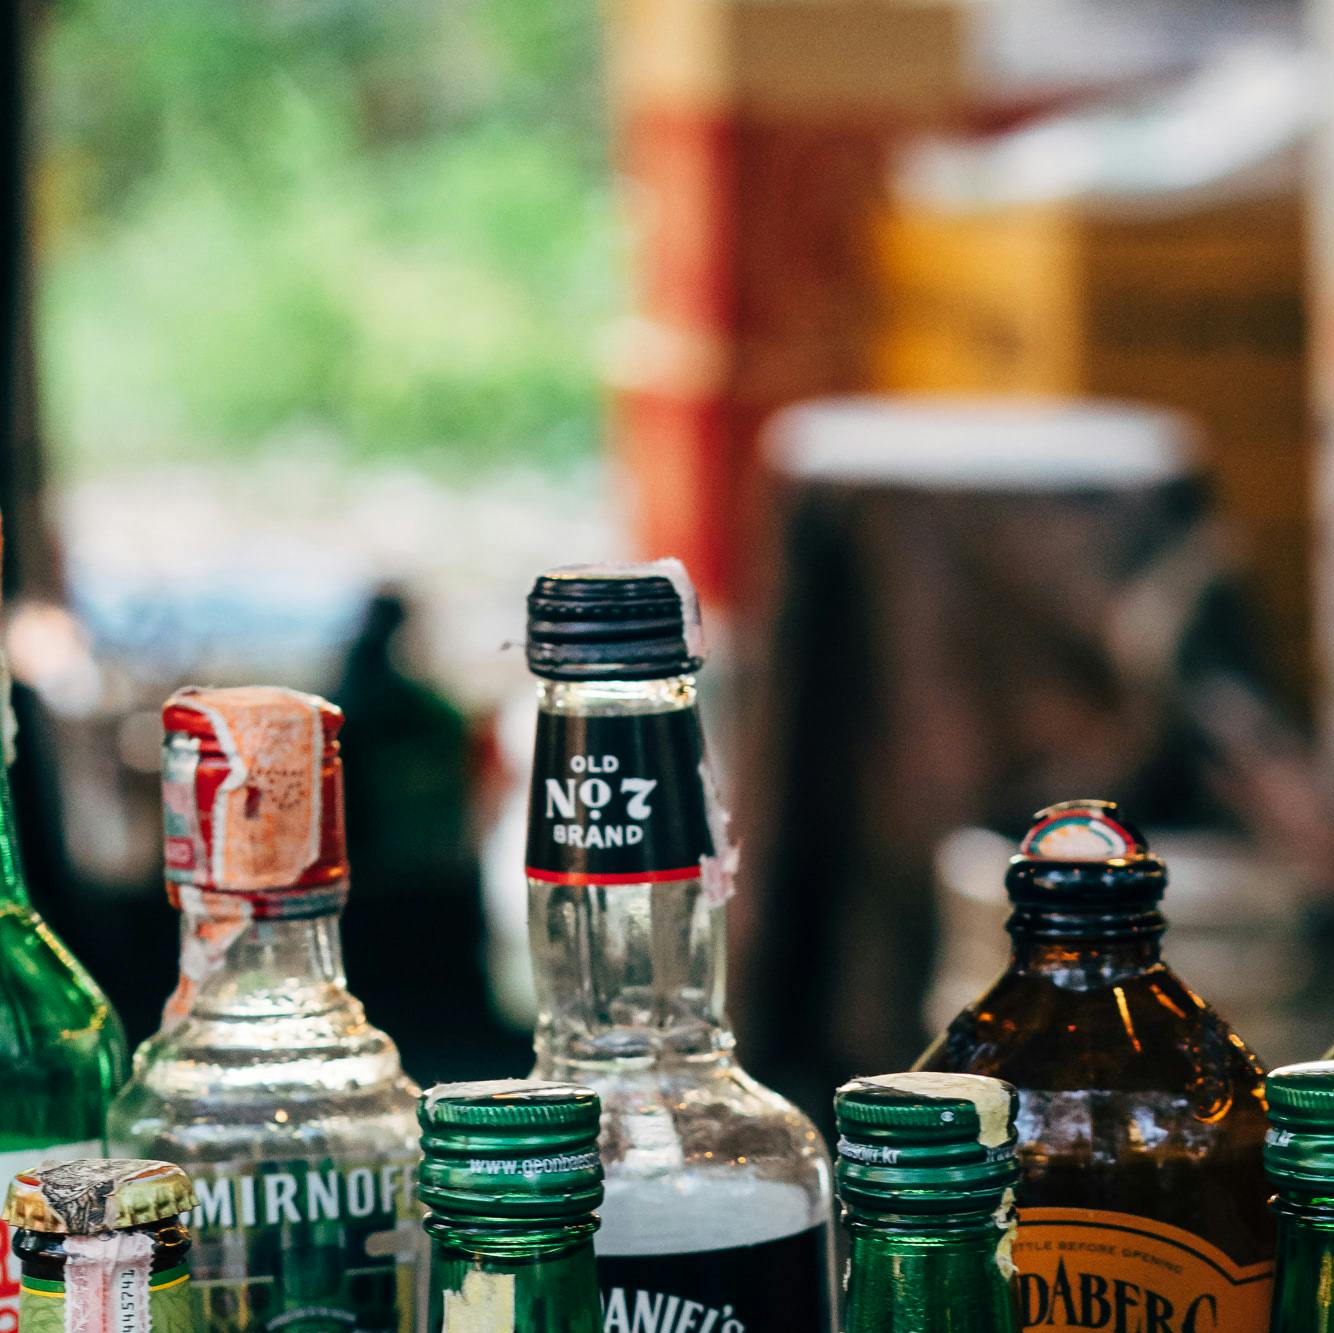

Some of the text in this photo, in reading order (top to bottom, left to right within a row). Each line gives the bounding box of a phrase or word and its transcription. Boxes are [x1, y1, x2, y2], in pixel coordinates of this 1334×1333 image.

[569, 754, 620, 774] OLD
[619, 777, 658, 821] 7
[552, 823, 644, 849] BRAND
[182, 1165, 414, 1228] MIRNOFF
[1057, 1241, 1117, 1259] BEFORE
[1121, 1246, 1184, 1275] OPENING
